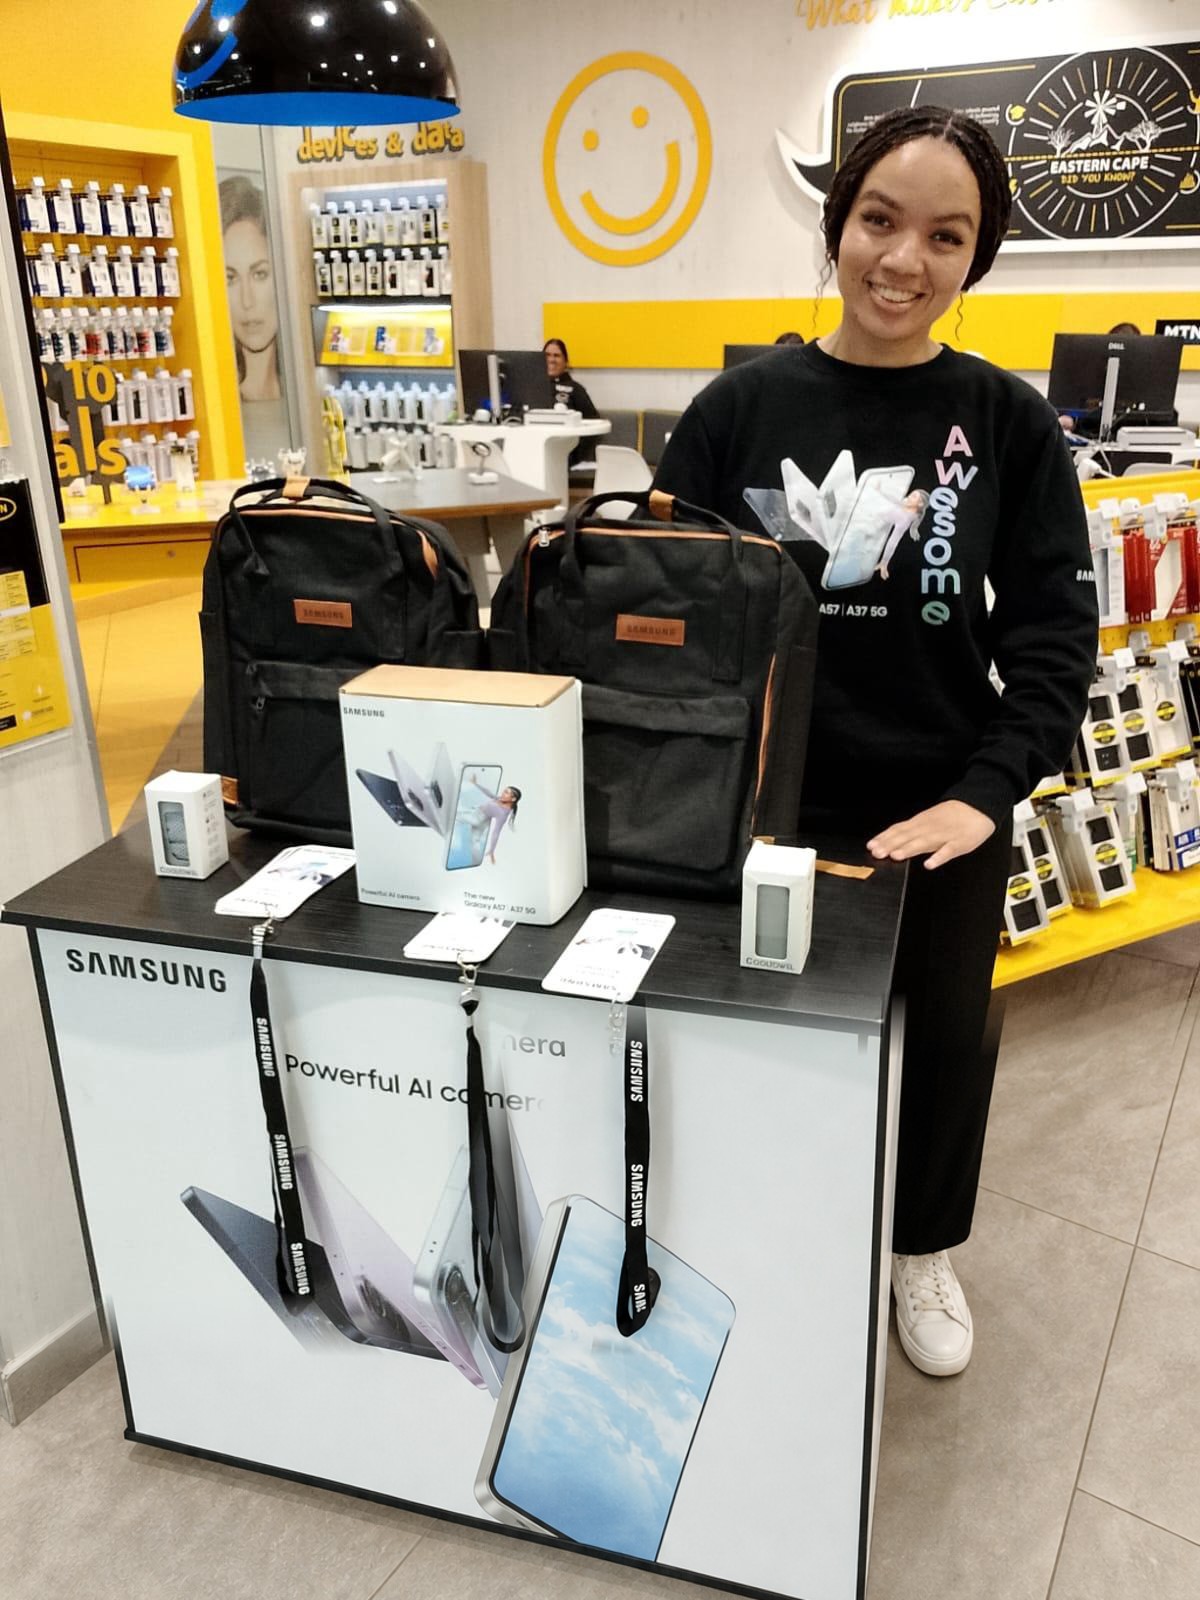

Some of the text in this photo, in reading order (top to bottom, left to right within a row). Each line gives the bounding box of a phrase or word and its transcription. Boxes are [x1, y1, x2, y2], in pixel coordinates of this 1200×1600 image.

[386, 131, 403, 156] &
[413, 121, 465, 155] data
[1050, 156, 1149, 175] EASTERN CAPE
[1061, 174, 1079, 184] DID
[1082, 173, 1101, 183] YOU
[1164, 325, 1200, 340] MTN
[819, 603, 840, 615] A57
[846, 604, 868, 617] A37
[870, 606, 887, 617] 5G
[343, 706, 386, 718] SAMSUNG
[66, 949, 228, 993] SAMSUNG
[256, 1017, 276, 1078] SAMSUNG
[285, 1053, 401, 1094] Powerful
[408, 1078, 432, 1099] AI
[274, 1133, 293, 1190] SAMSUNG
[631, 1164, 643, 1227] SAMSUNG
[290, 1242, 310, 1296] SAMSUNG
